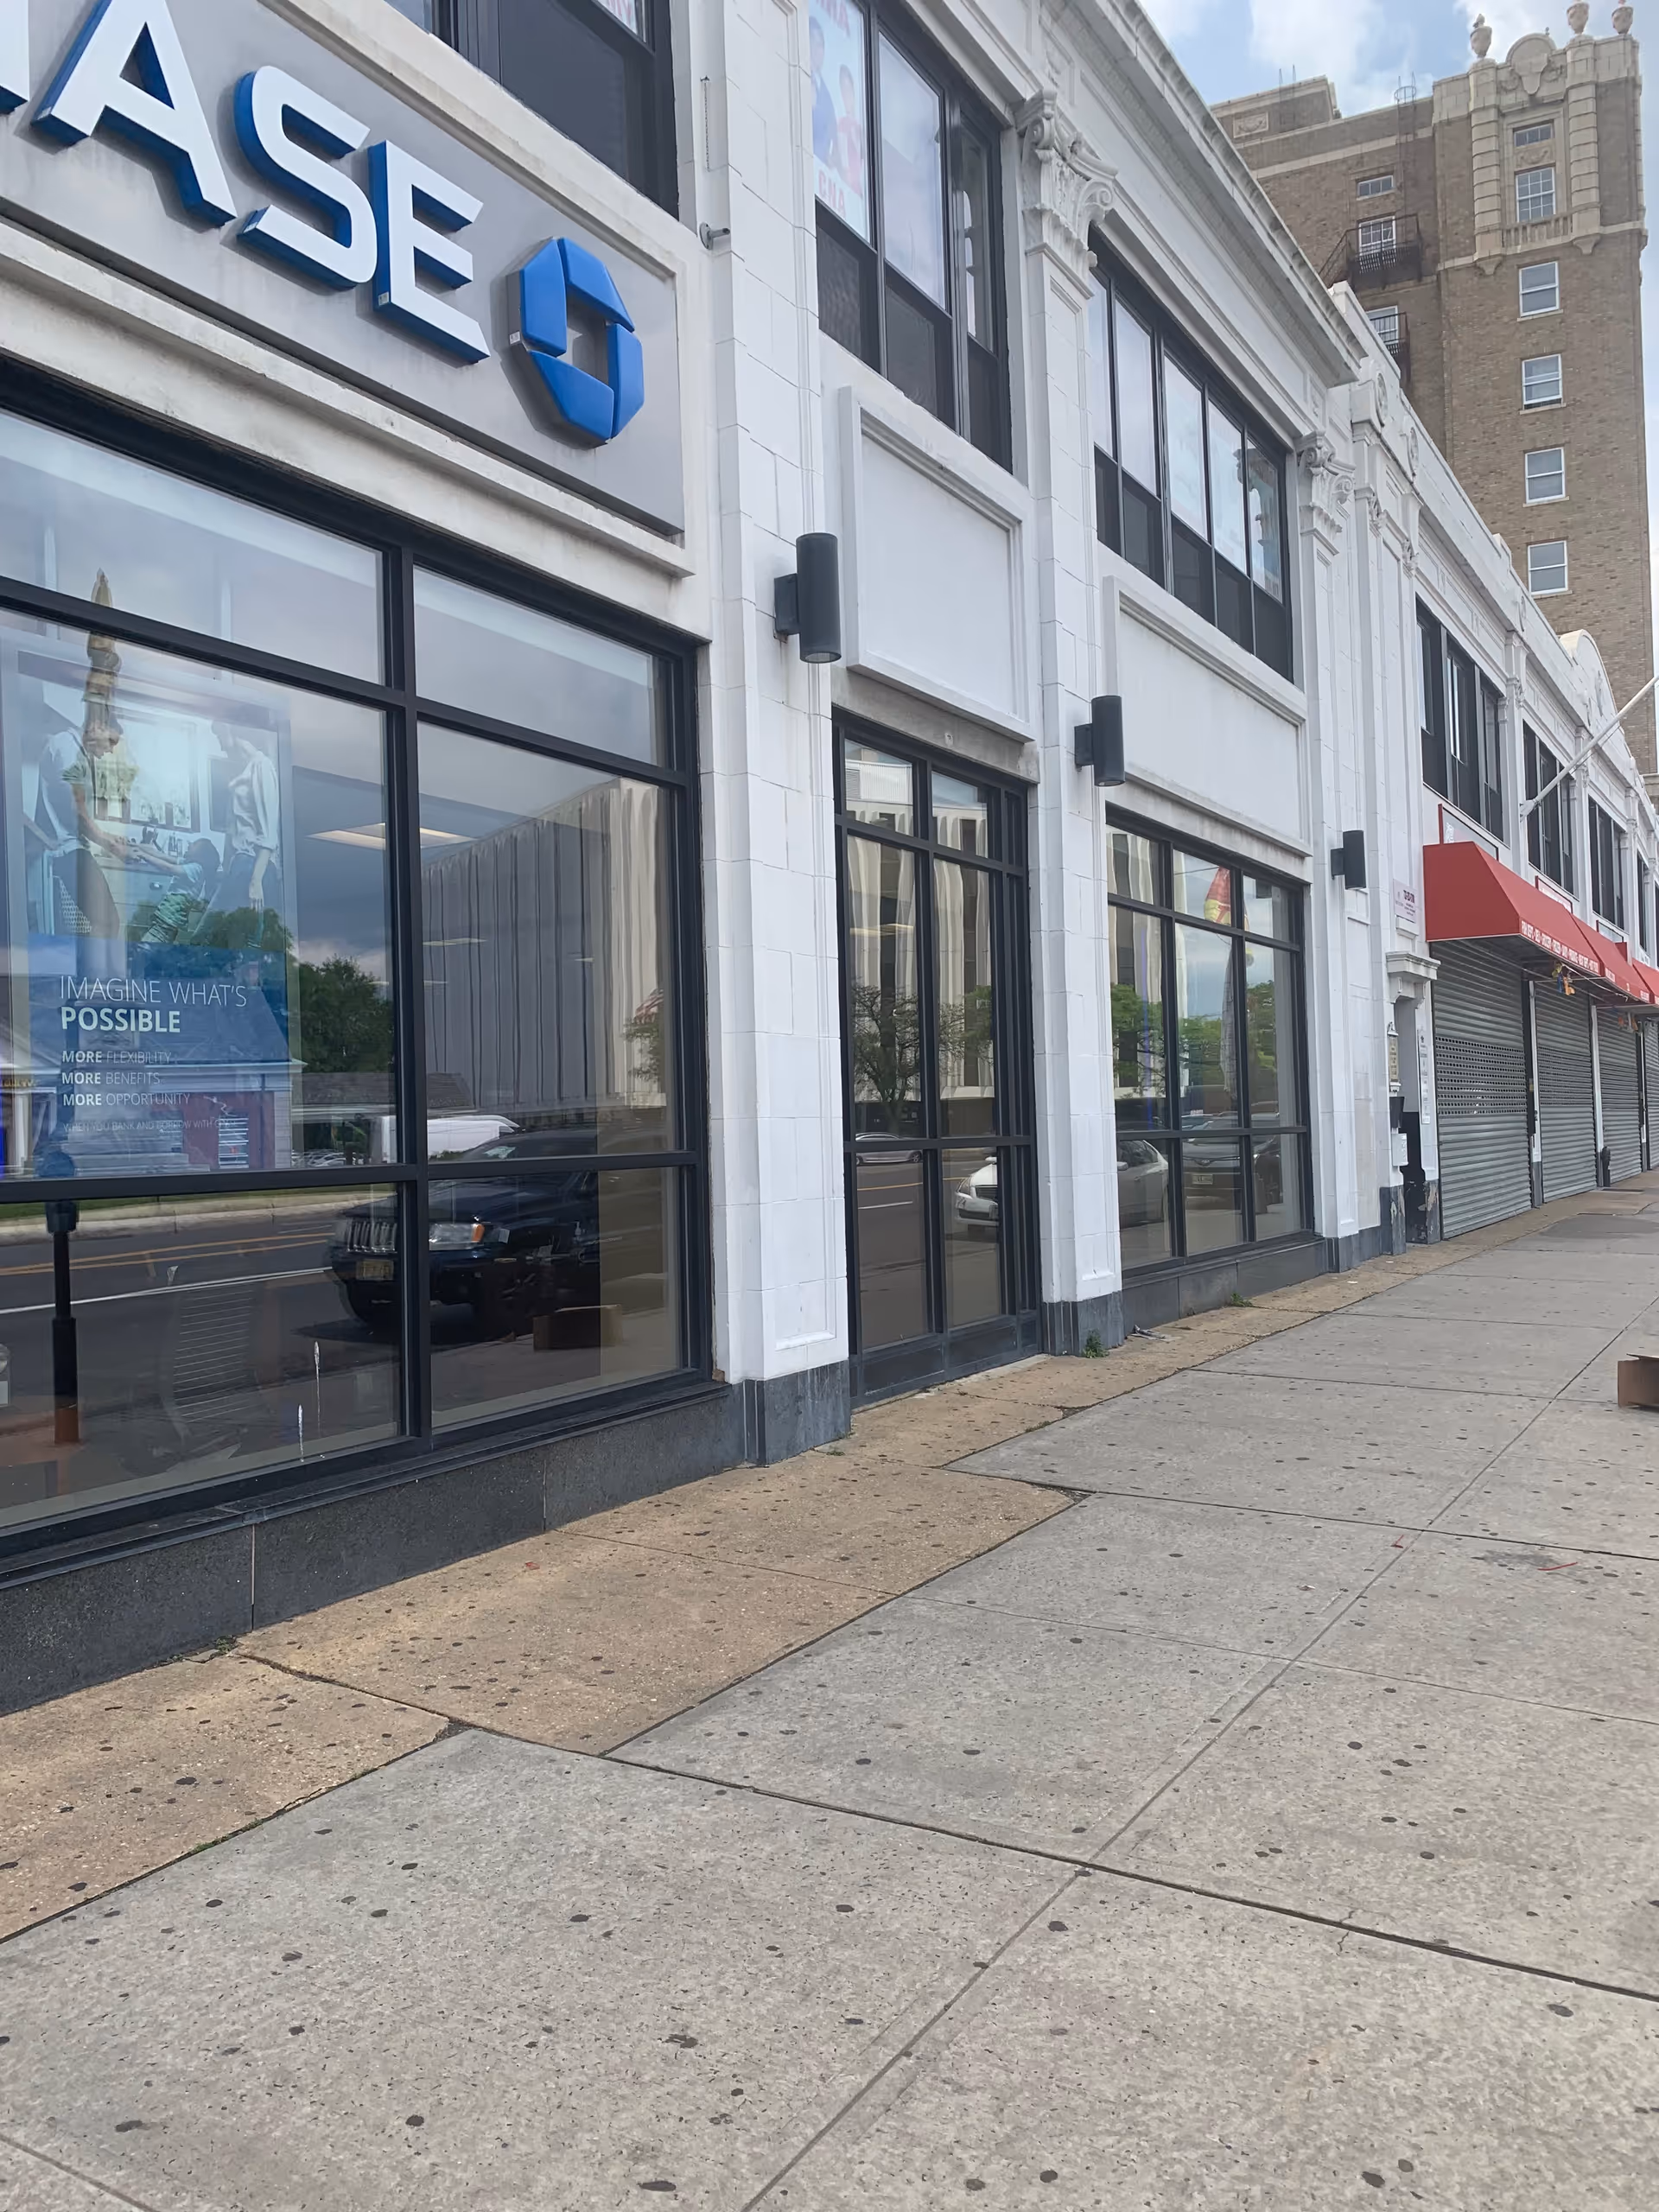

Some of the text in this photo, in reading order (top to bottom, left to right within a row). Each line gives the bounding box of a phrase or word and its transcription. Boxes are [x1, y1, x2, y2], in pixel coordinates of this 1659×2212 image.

[0, 0, 490, 363] ASE
[60, 976, 247, 1007] IMAGINE WHAT'S
[61, 1007, 181, 1033] POSSIBLE
[62, 1051, 172, 1064] MORE FLEXIBILITY
[62, 1072, 161, 1085] MORE BENEFITS
[63, 1093, 190, 1106] MORE OPPORTUNITY
[111, 1122, 135, 1131] BANK
[137, 1121, 154, 1130] AND
